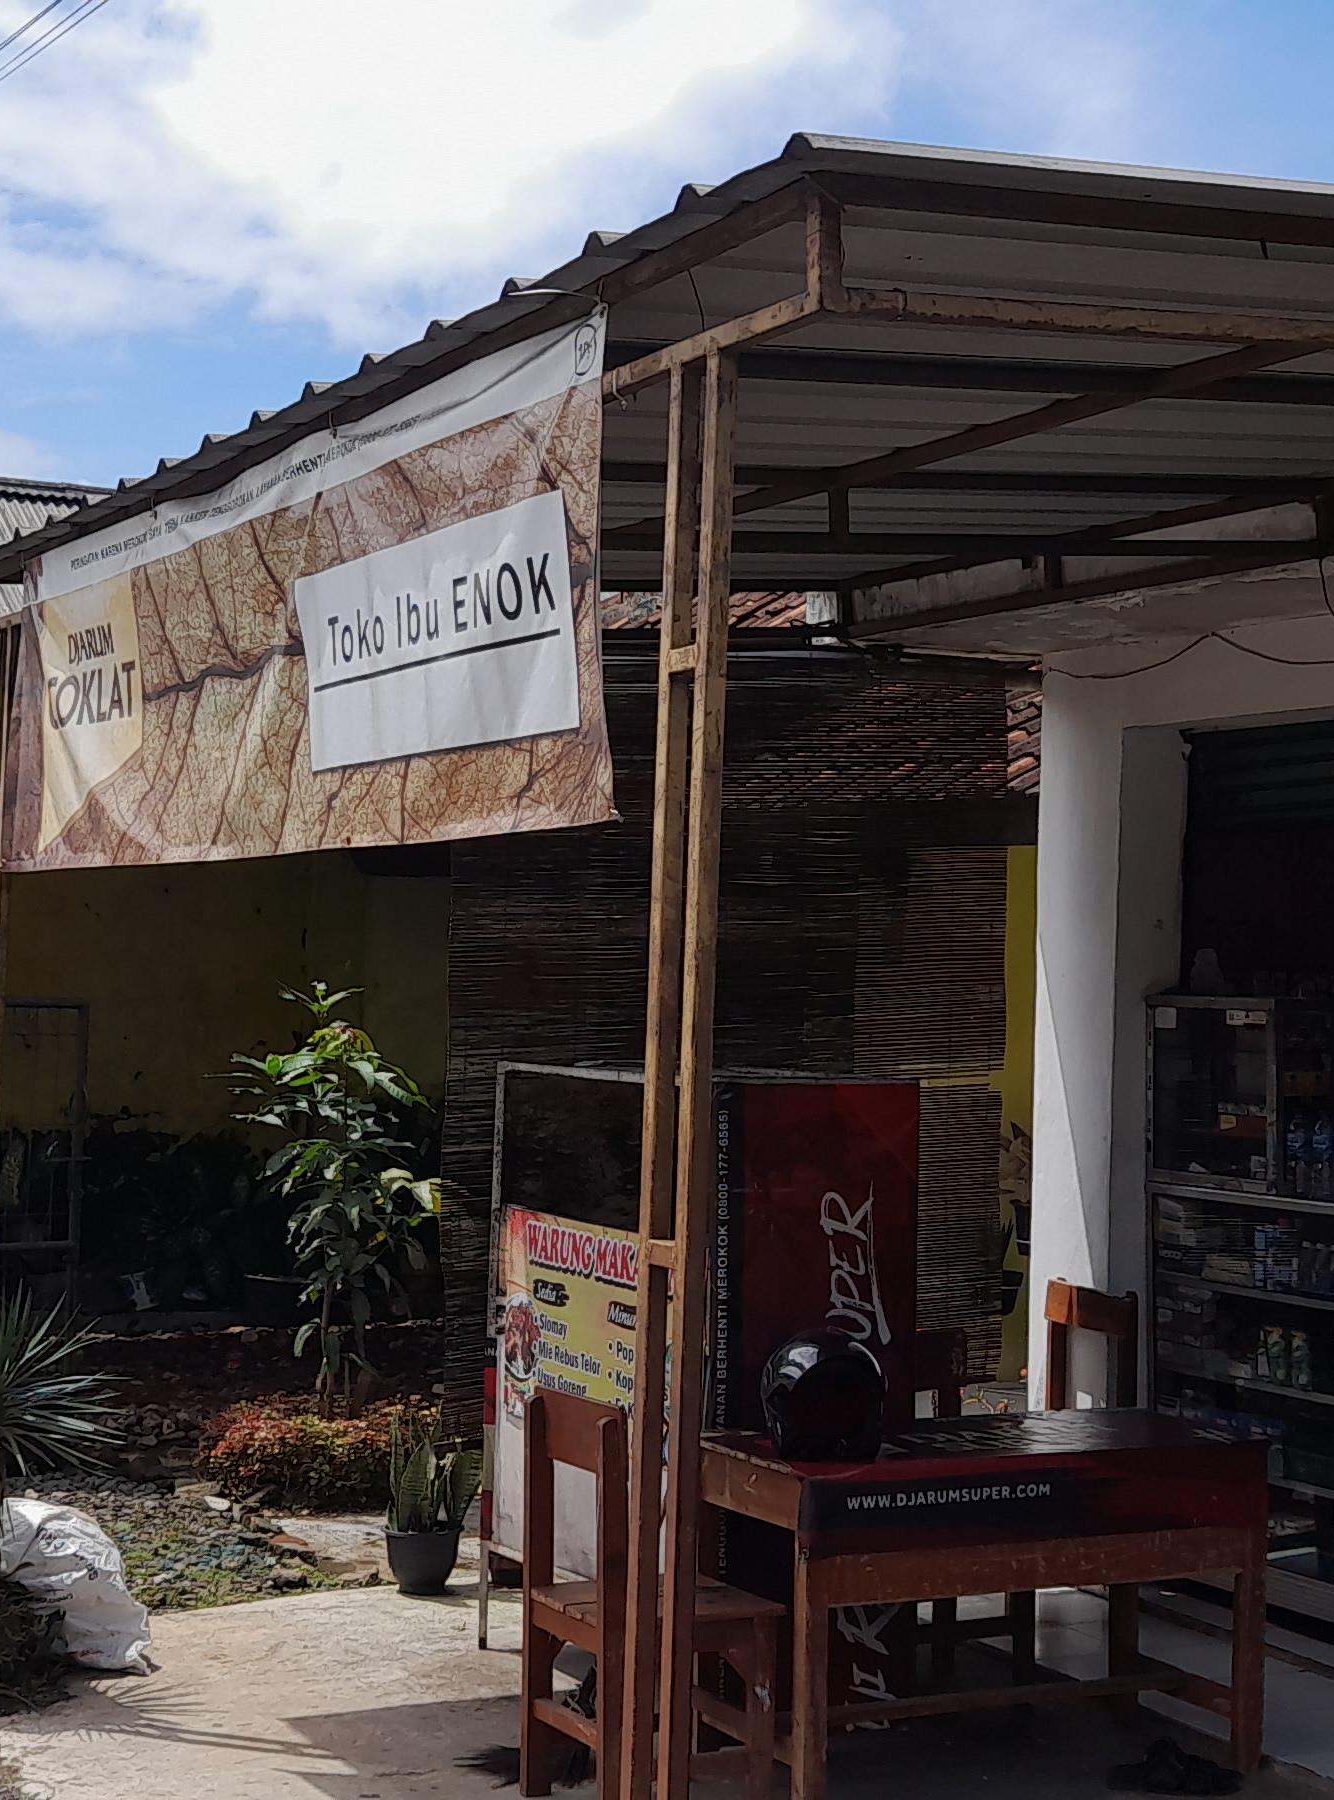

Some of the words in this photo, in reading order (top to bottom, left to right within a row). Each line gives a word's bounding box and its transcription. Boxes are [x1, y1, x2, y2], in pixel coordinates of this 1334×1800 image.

[327, 608, 385, 667] Toko
[396, 592, 440, 648] Ibu
[452, 552, 557, 634] ENOK
[68, 622, 115, 667] DJARUM
[48, 659, 135, 730] COKLAT
[718, 1109, 731, 1219] (0800-177-6565)
[527, 1222, 594, 1272] WARUNG
[717, 1224, 729, 1300] MEROKOK
[819, 1180, 893, 1347] UPER
[539, 1313, 567, 1341] Siomay
[717, 1304, 728, 1379] BERHENTI
[538, 1341, 554, 1357] Mie
[554, 1345, 579, 1369] Rebus
[616, 1341, 634, 1365] Pop
[537, 1368, 556, 1387] Usus
[557, 1375, 587, 1397] Goreng
[715, 1384, 727, 1430] ANAN
[846, 1482, 1051, 1511] WWW.DJARUMSUPER.COM
